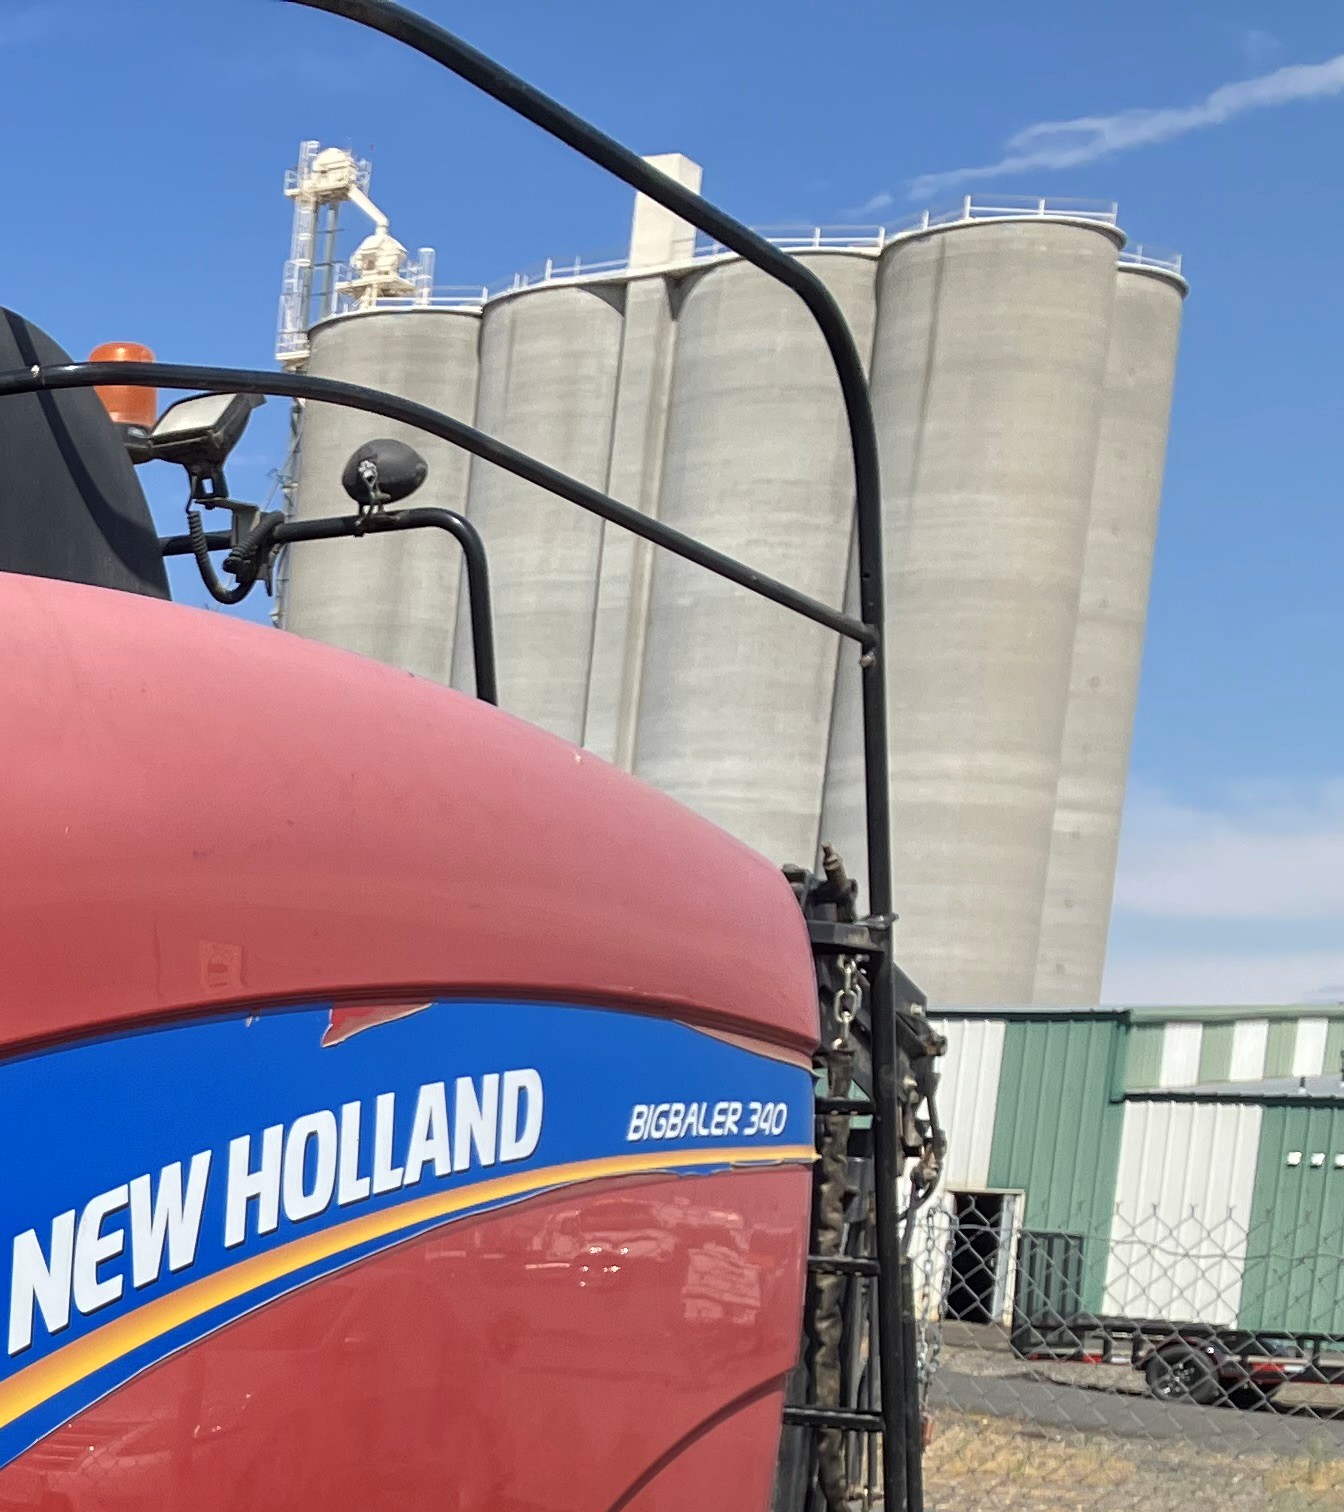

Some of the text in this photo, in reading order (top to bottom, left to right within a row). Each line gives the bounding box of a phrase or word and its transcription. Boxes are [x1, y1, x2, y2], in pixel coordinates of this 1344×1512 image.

[625, 1101, 788, 1142] BIGBALER 340
[8, 1068, 544, 1356] NEW HOLLAND
